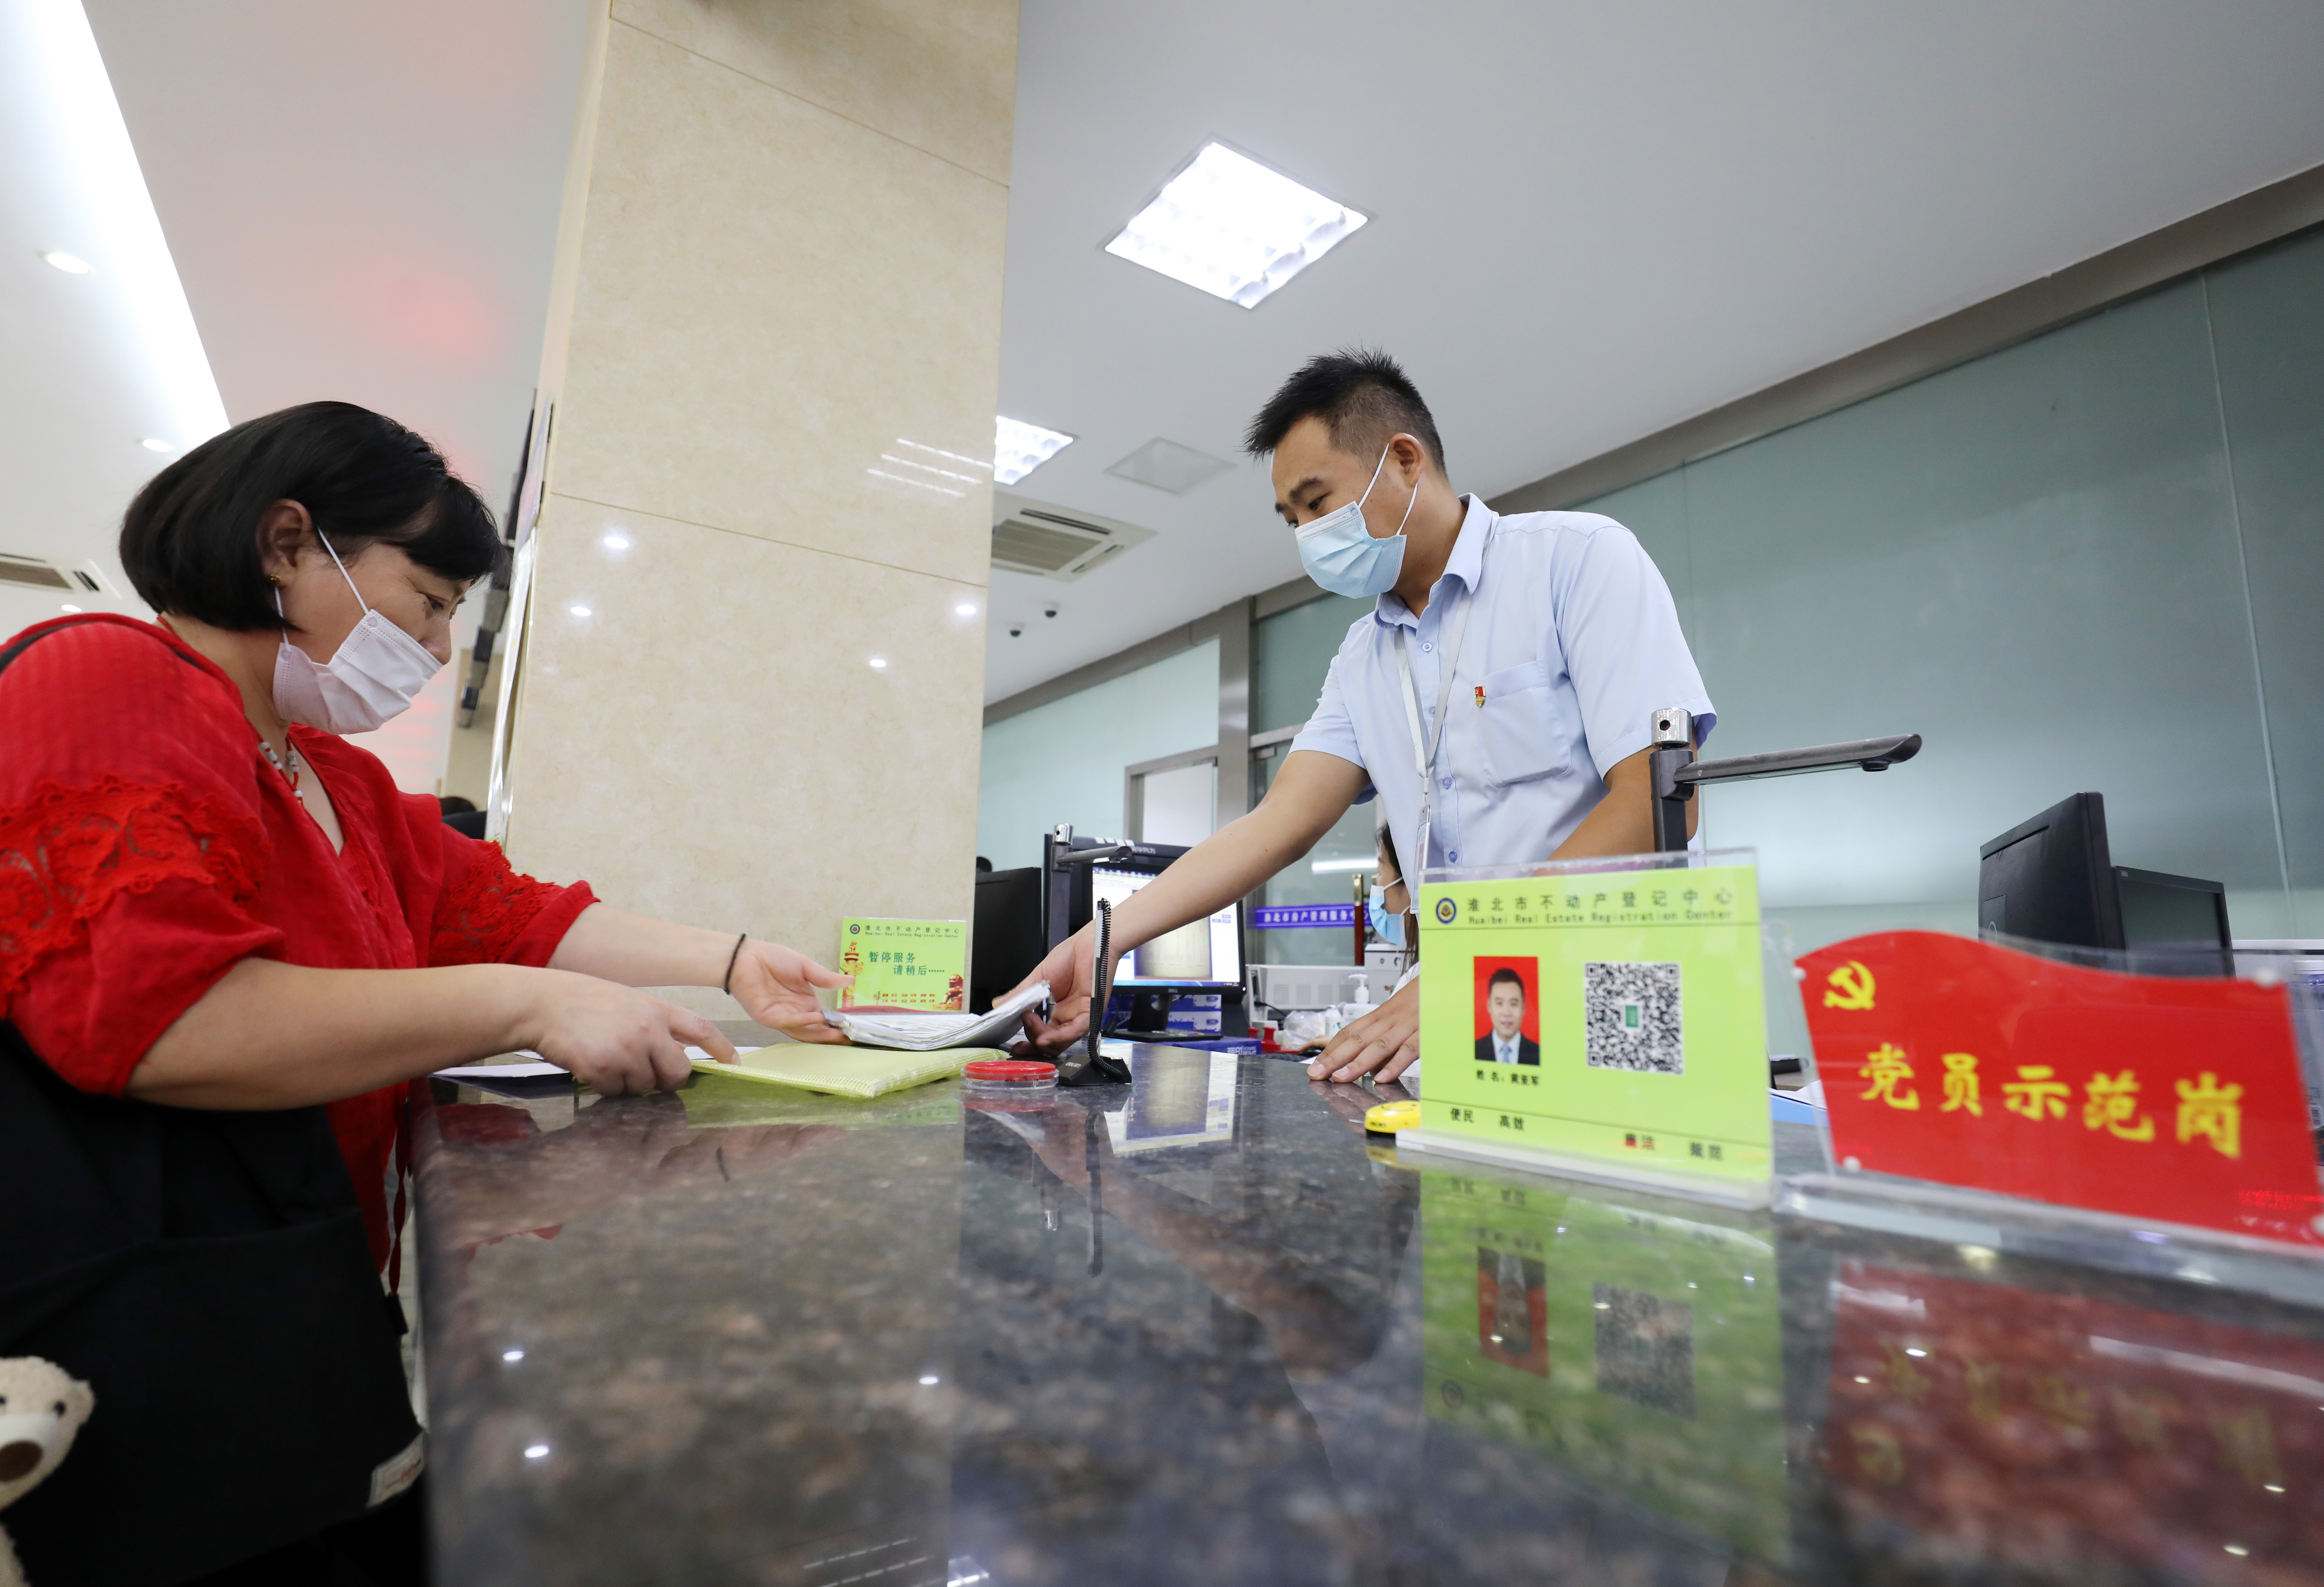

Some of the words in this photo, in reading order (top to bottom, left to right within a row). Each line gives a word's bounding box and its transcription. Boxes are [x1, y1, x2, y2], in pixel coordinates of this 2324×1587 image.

[1468, 888, 1732, 911] 淮北市不动产登记中心
[1515, 915, 1538, 924] Real
[865, 925, 959, 934] 淮北市不动产登记中心
[869, 952, 915, 963] 暂停服务
[1860, 1043, 2245, 1159] 党员示范岗
[1451, 1108, 1474, 1123] 便民
[1500, 1116, 1525, 1130] 高效
